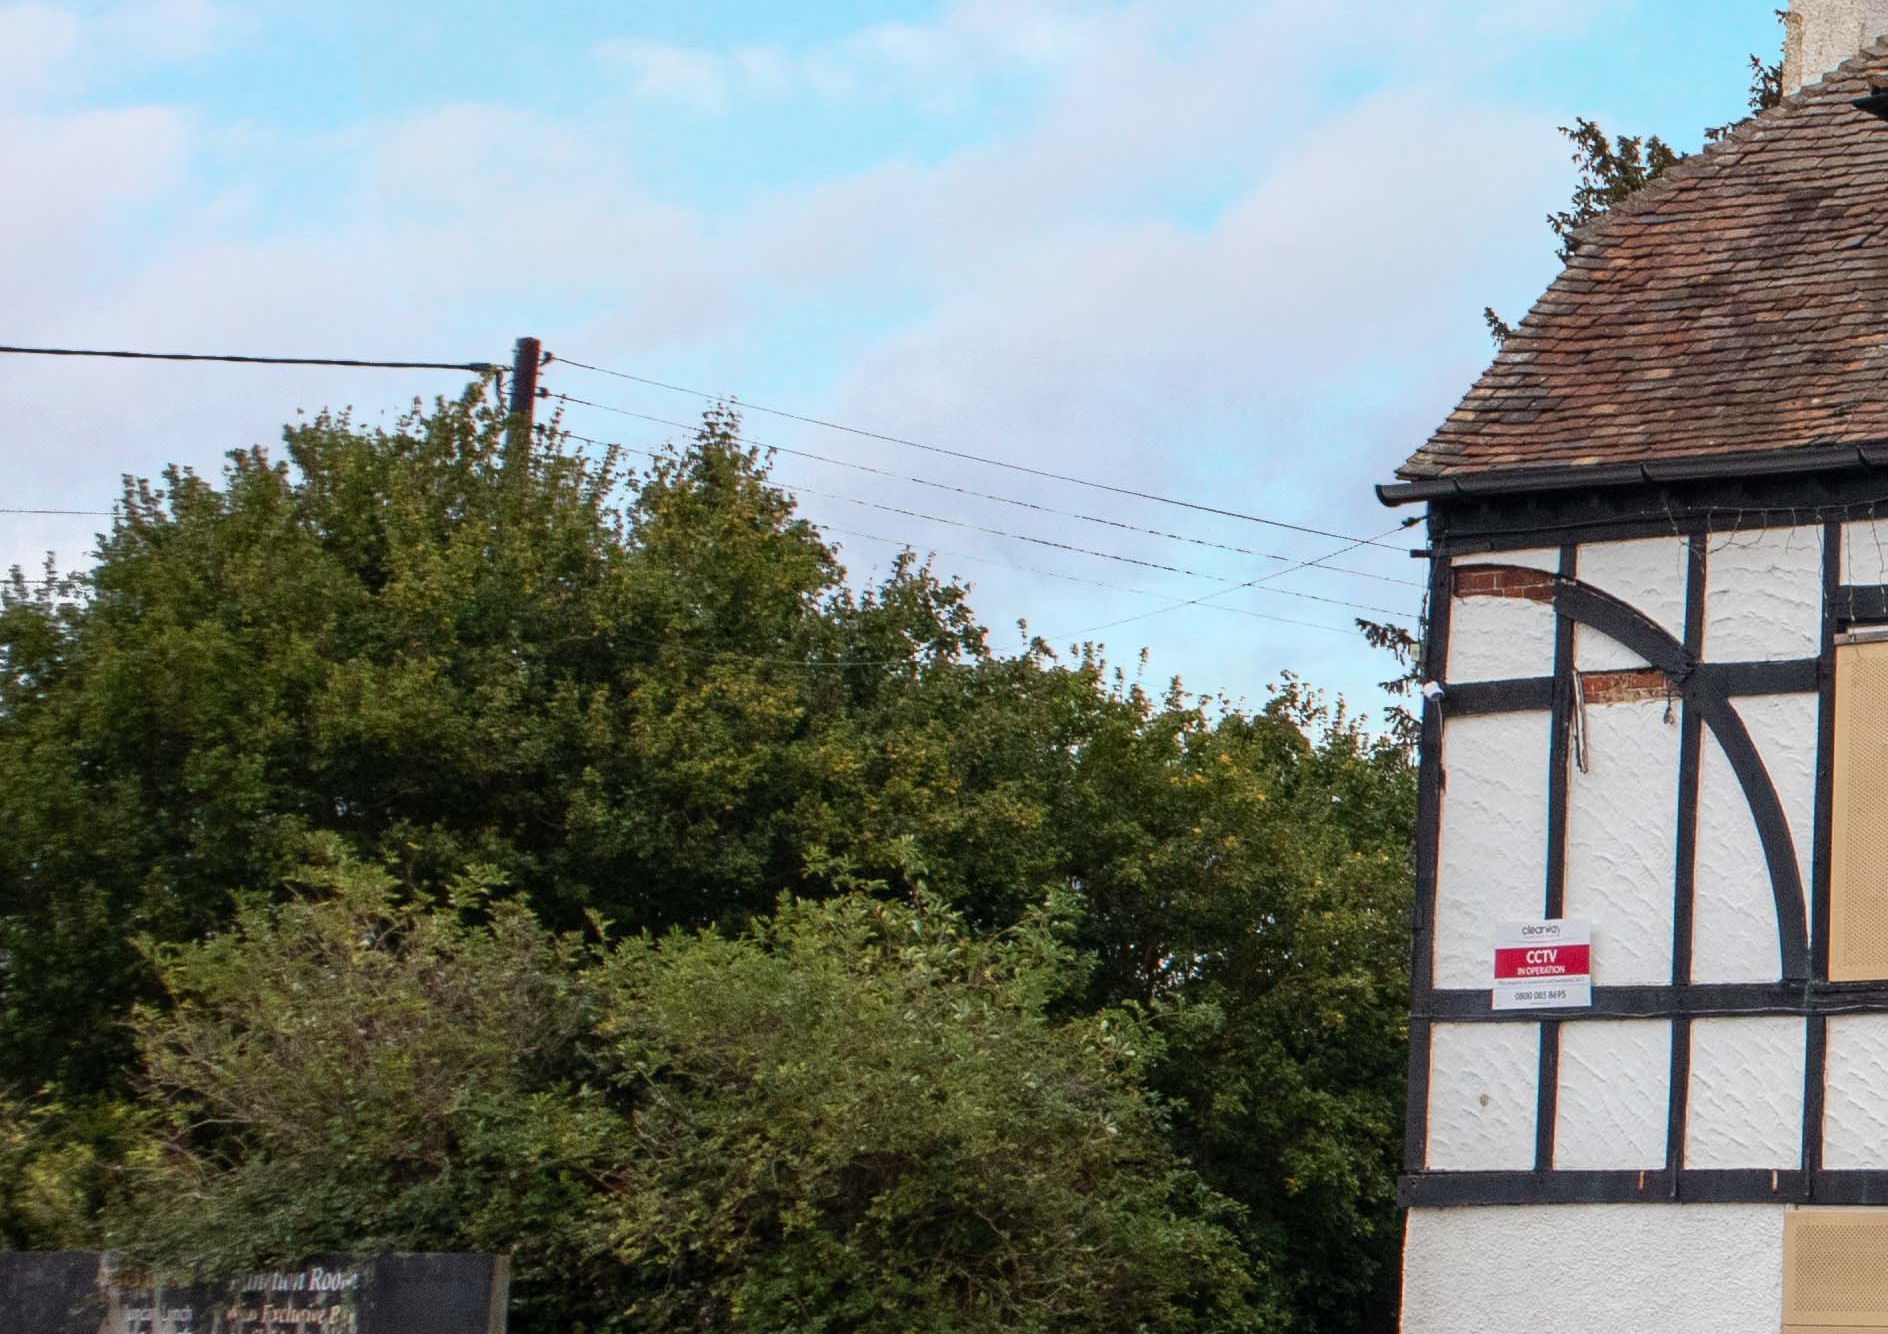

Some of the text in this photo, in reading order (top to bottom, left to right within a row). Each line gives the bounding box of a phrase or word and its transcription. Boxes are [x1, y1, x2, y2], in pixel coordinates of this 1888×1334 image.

[1526, 949, 1558, 964] CCTV
[1517, 965, 1566, 976] IN OPERATION
